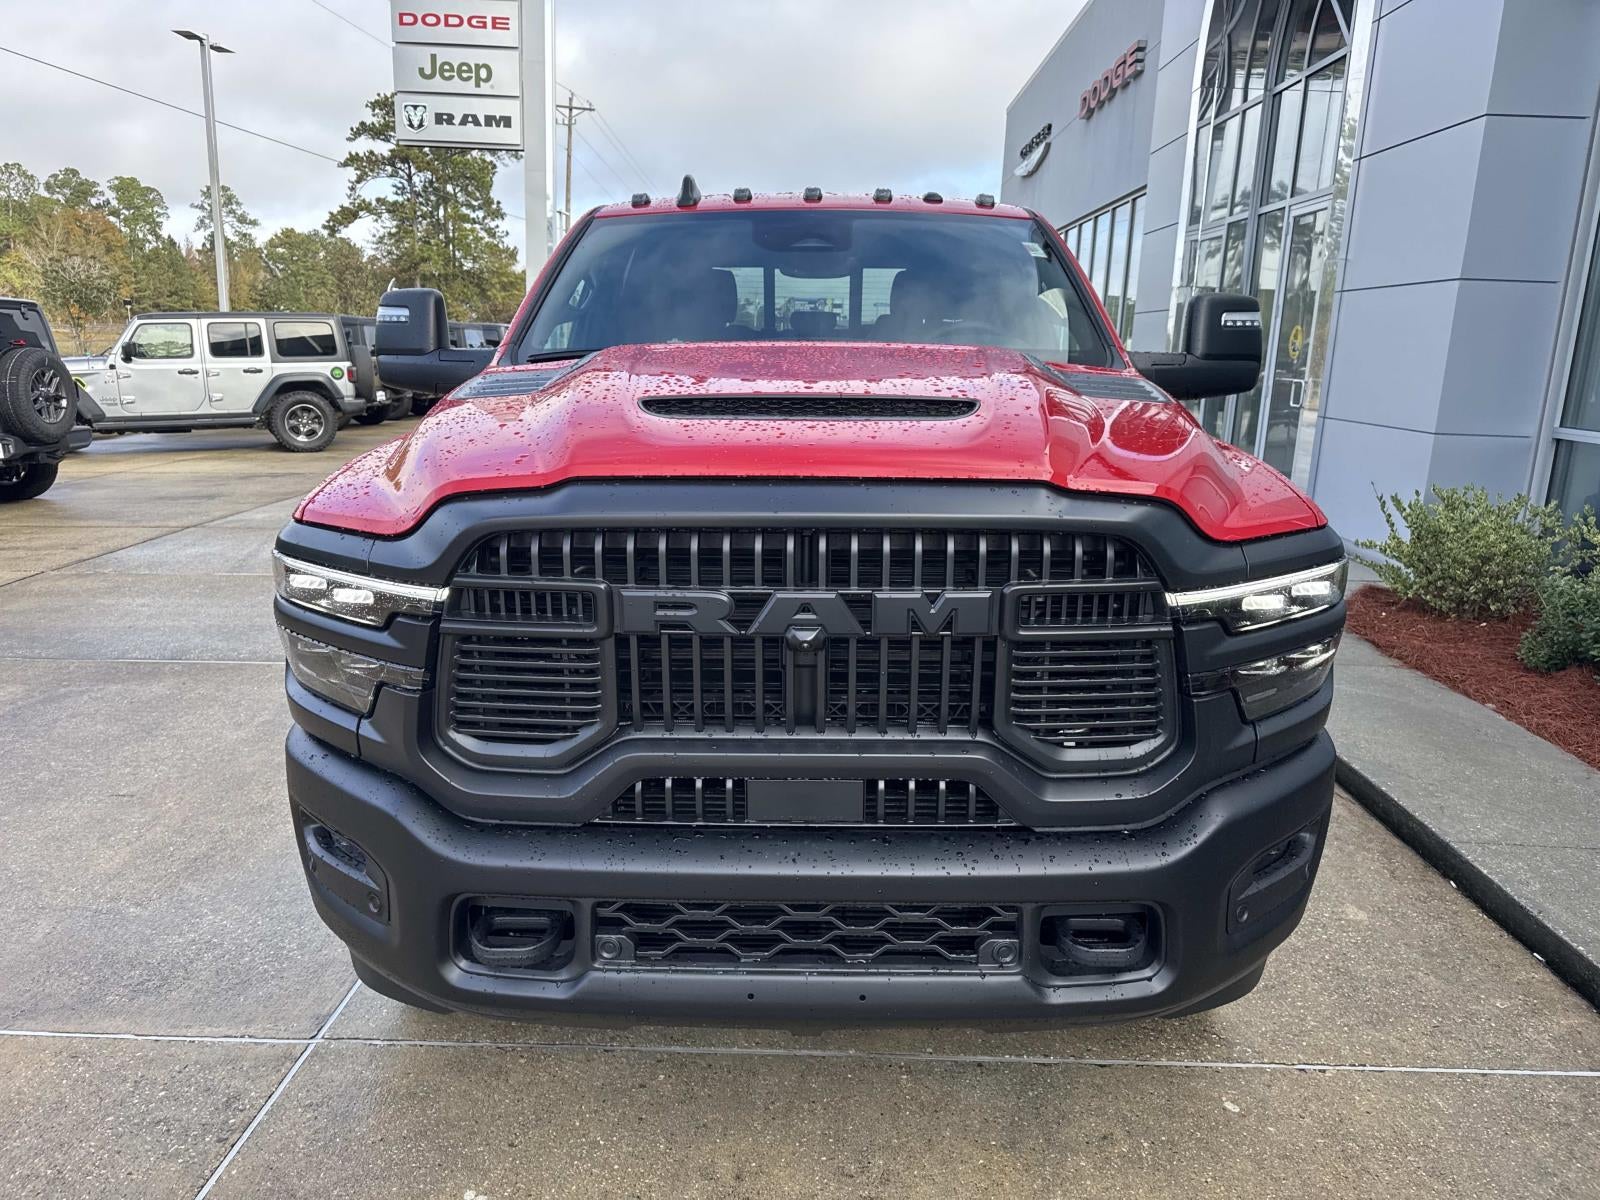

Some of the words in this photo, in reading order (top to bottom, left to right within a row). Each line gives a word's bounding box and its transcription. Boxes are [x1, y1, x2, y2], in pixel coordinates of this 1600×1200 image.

[398, 12, 511, 31] DODGE
[418, 53, 493, 88] Jeep
[1078, 39, 1148, 120] DODGE
[434, 112, 512, 129] RAM
[618, 589, 993, 637] RAM
